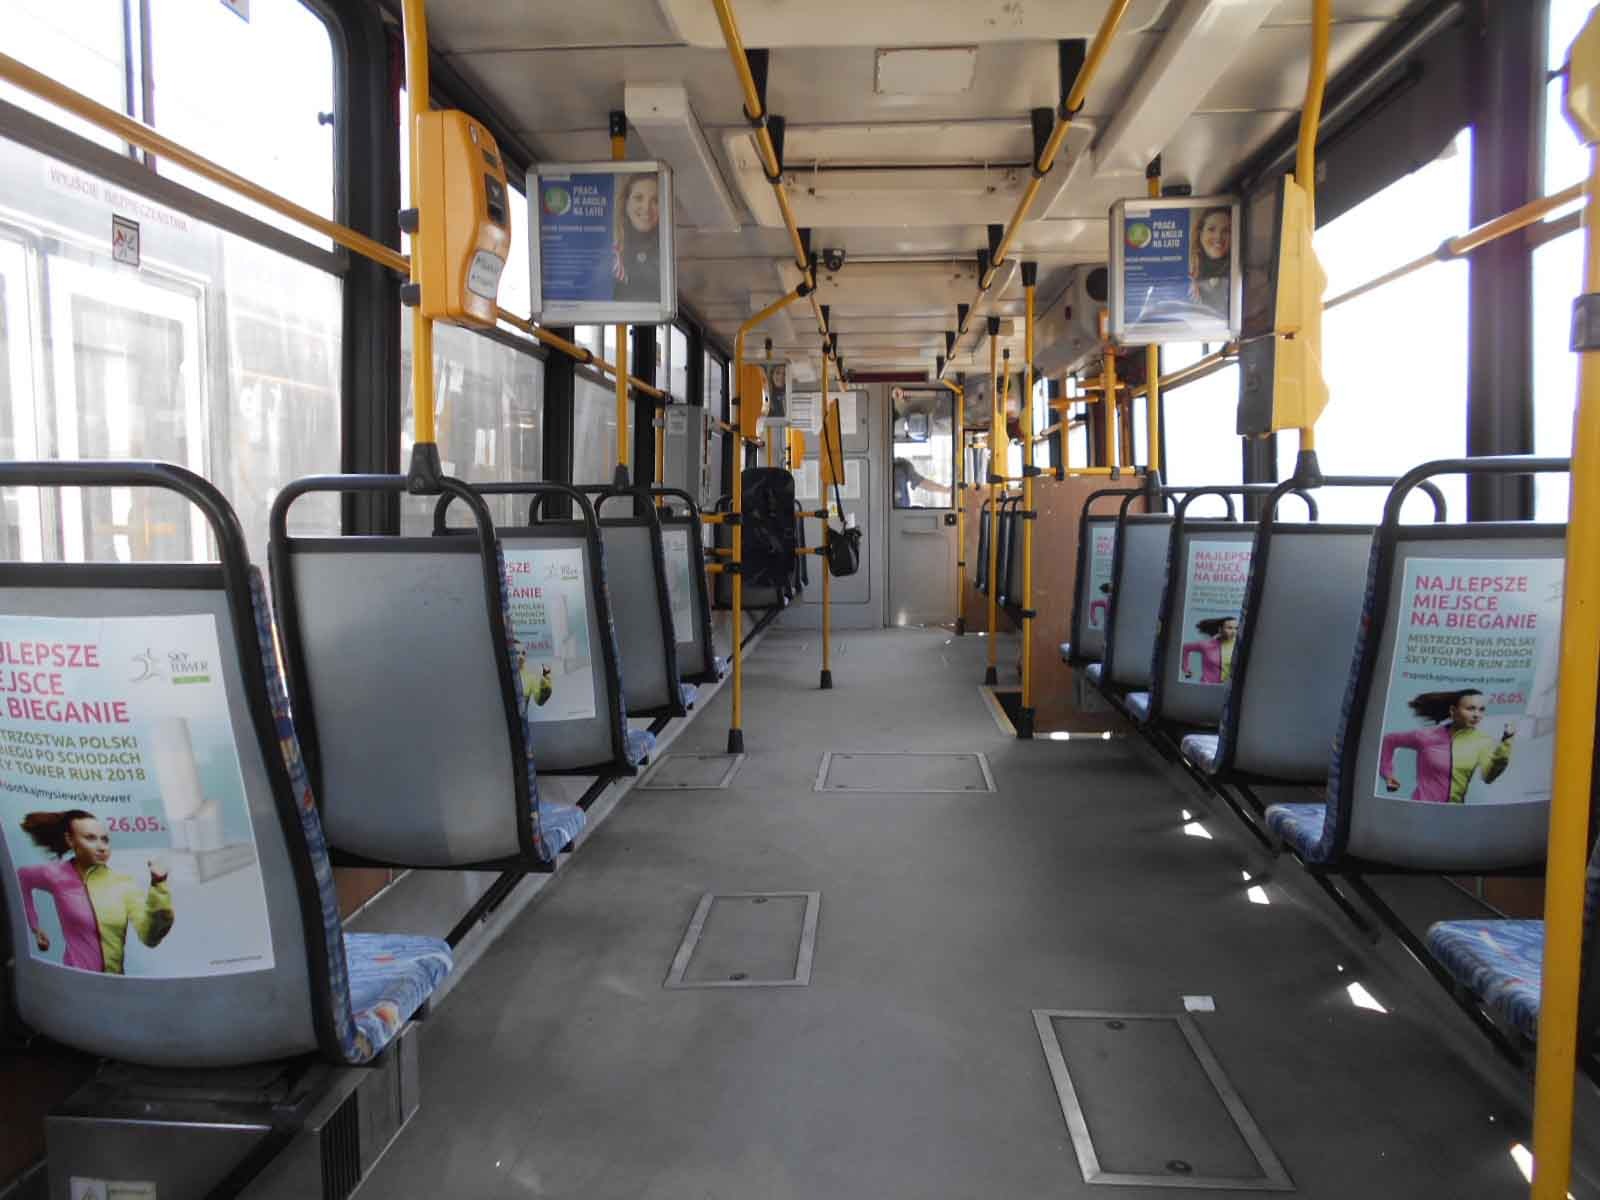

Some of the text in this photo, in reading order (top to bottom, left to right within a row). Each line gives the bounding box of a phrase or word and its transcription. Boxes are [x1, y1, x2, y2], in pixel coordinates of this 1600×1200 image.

[573, 185, 598, 195] PRACA
[1153, 221, 1176, 229] PRACA
[1415, 575, 1528, 592] NAJLEPSZE
[1413, 594, 1499, 611] MIEJSCE
[1410, 611, 1537, 629] NA BIEGANIE
[1408, 634, 1493, 647] MISTRZOSTWA
[1432, 656, 1475, 669] TOWER
[7, 697, 130, 723] BIEGANIE
[80, 736, 137, 750] POLSKI
[35, 748, 55, 762] PO
[57, 751, 141, 765] SCHODACH
[15, 761, 66, 779] TOWER
[69, 767, 102, 781] RUN
[107, 768, 146, 782] 2018
[107, 816, 167, 832] 26.05.
